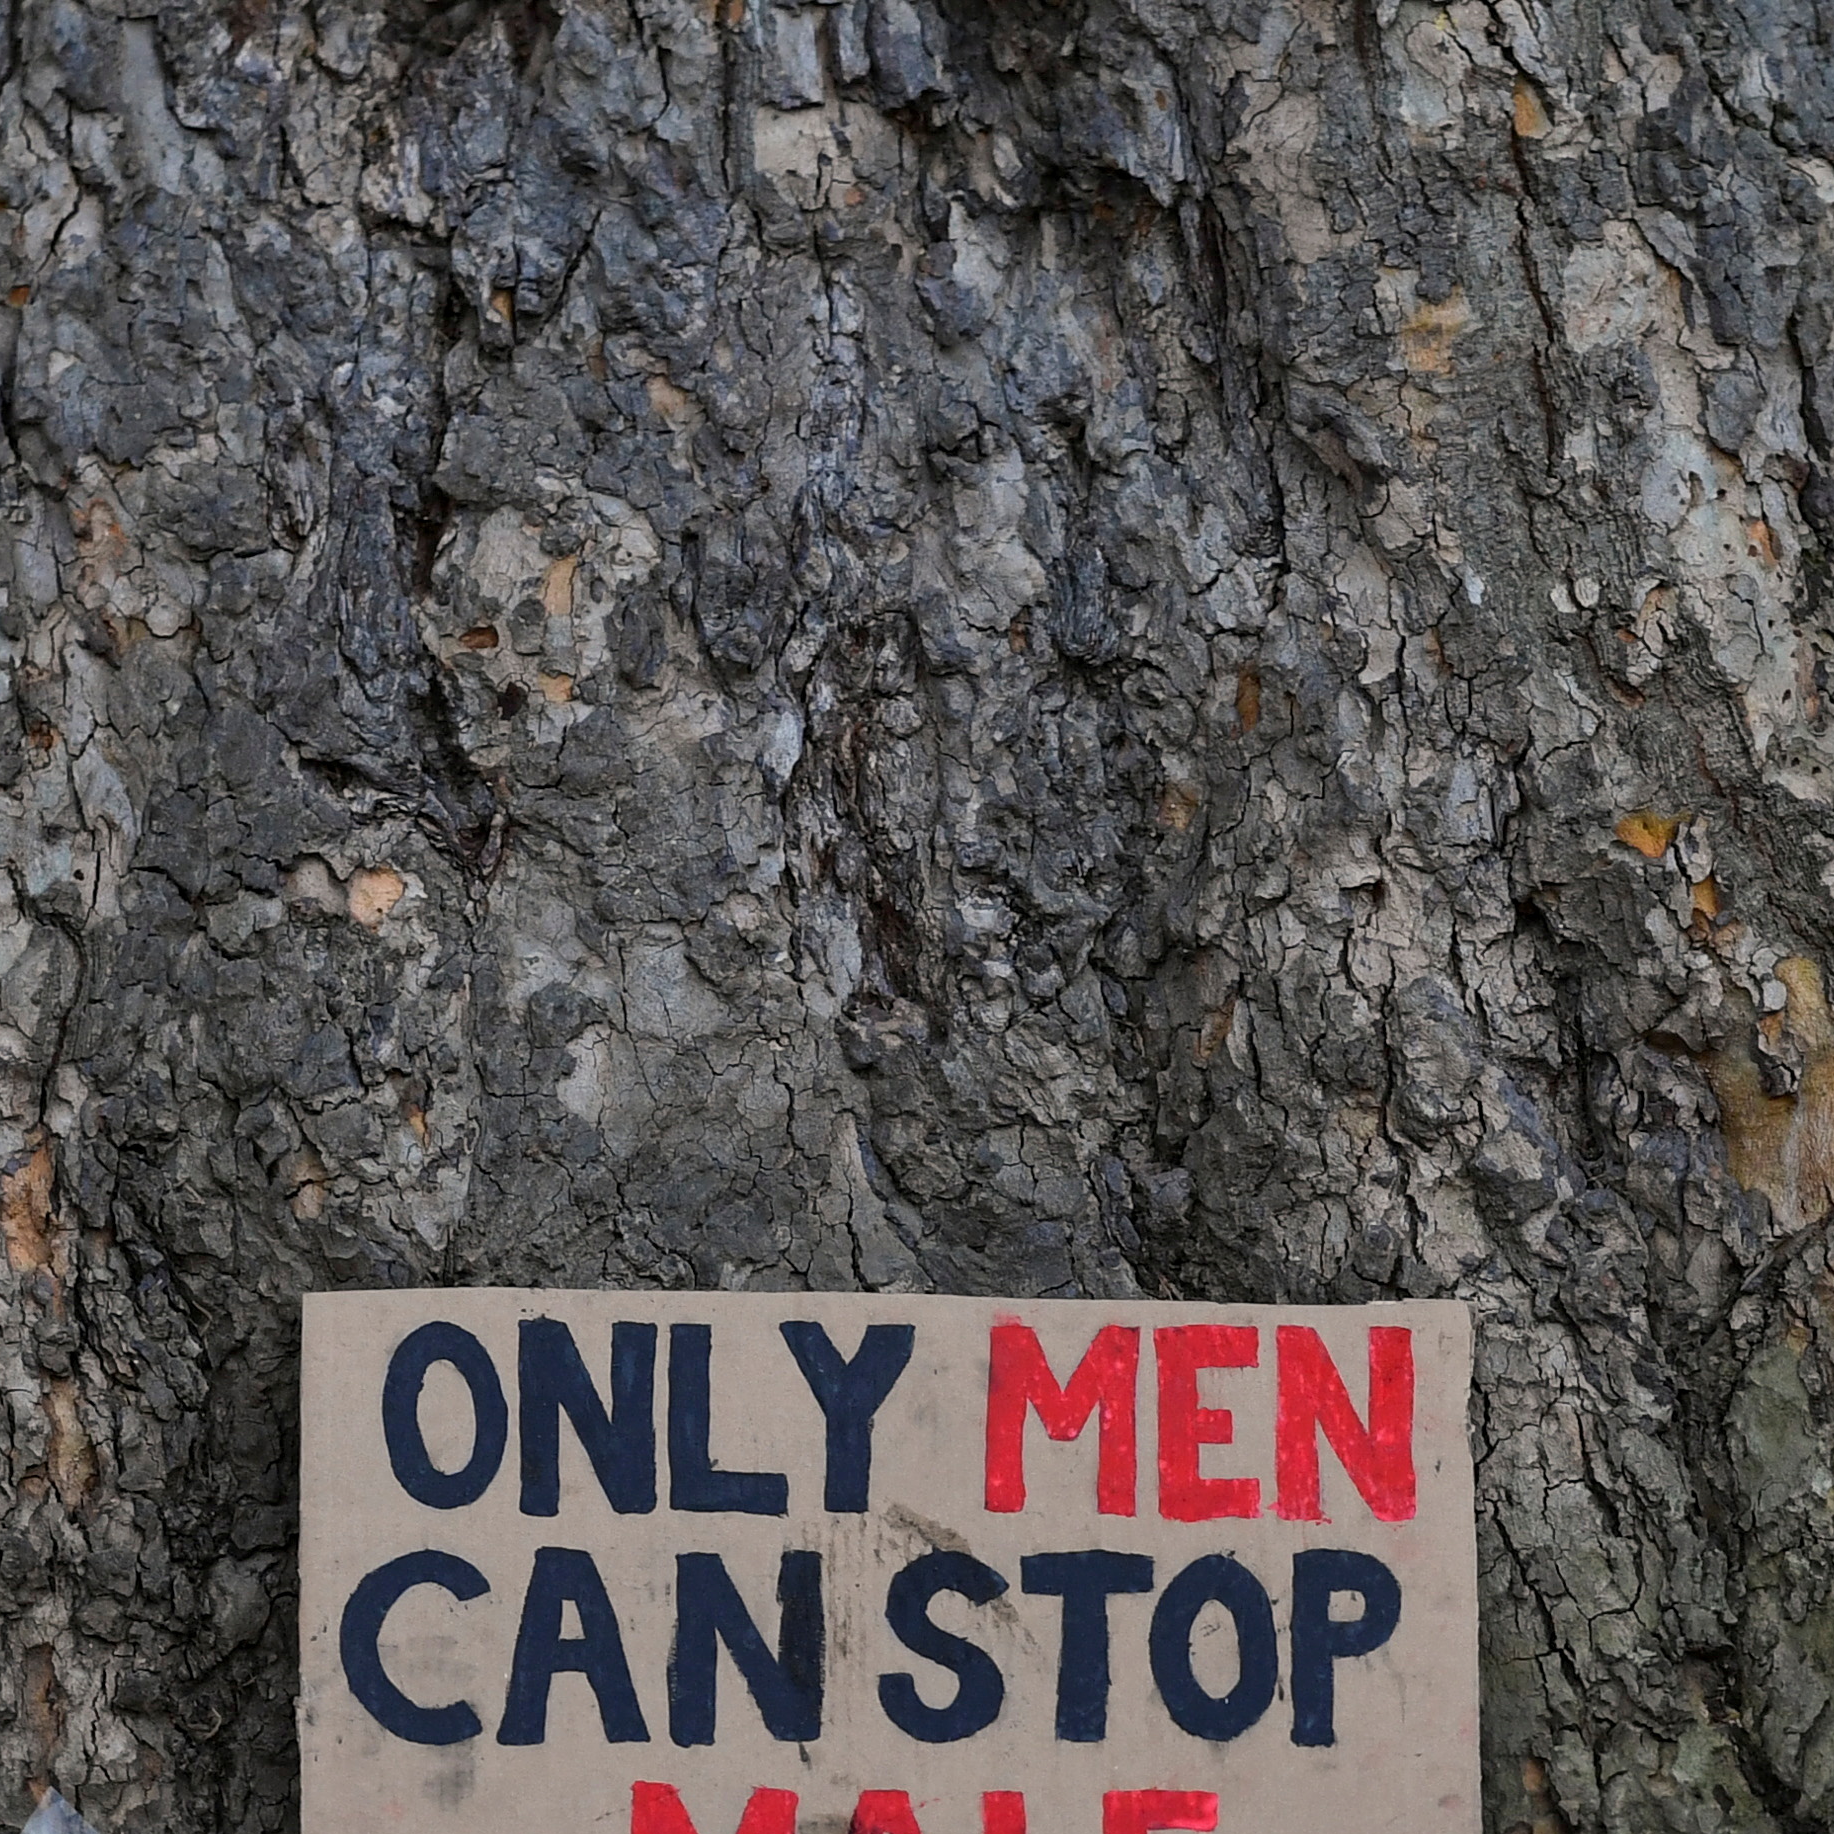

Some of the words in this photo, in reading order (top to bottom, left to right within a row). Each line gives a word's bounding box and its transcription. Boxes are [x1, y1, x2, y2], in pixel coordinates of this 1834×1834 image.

[380, 1316, 915, 1518] ONLY
[983, 1320, 1417, 1522] MEN
[338, 1545, 826, 1748] CAN
[877, 1546, 1403, 1748] STOP
